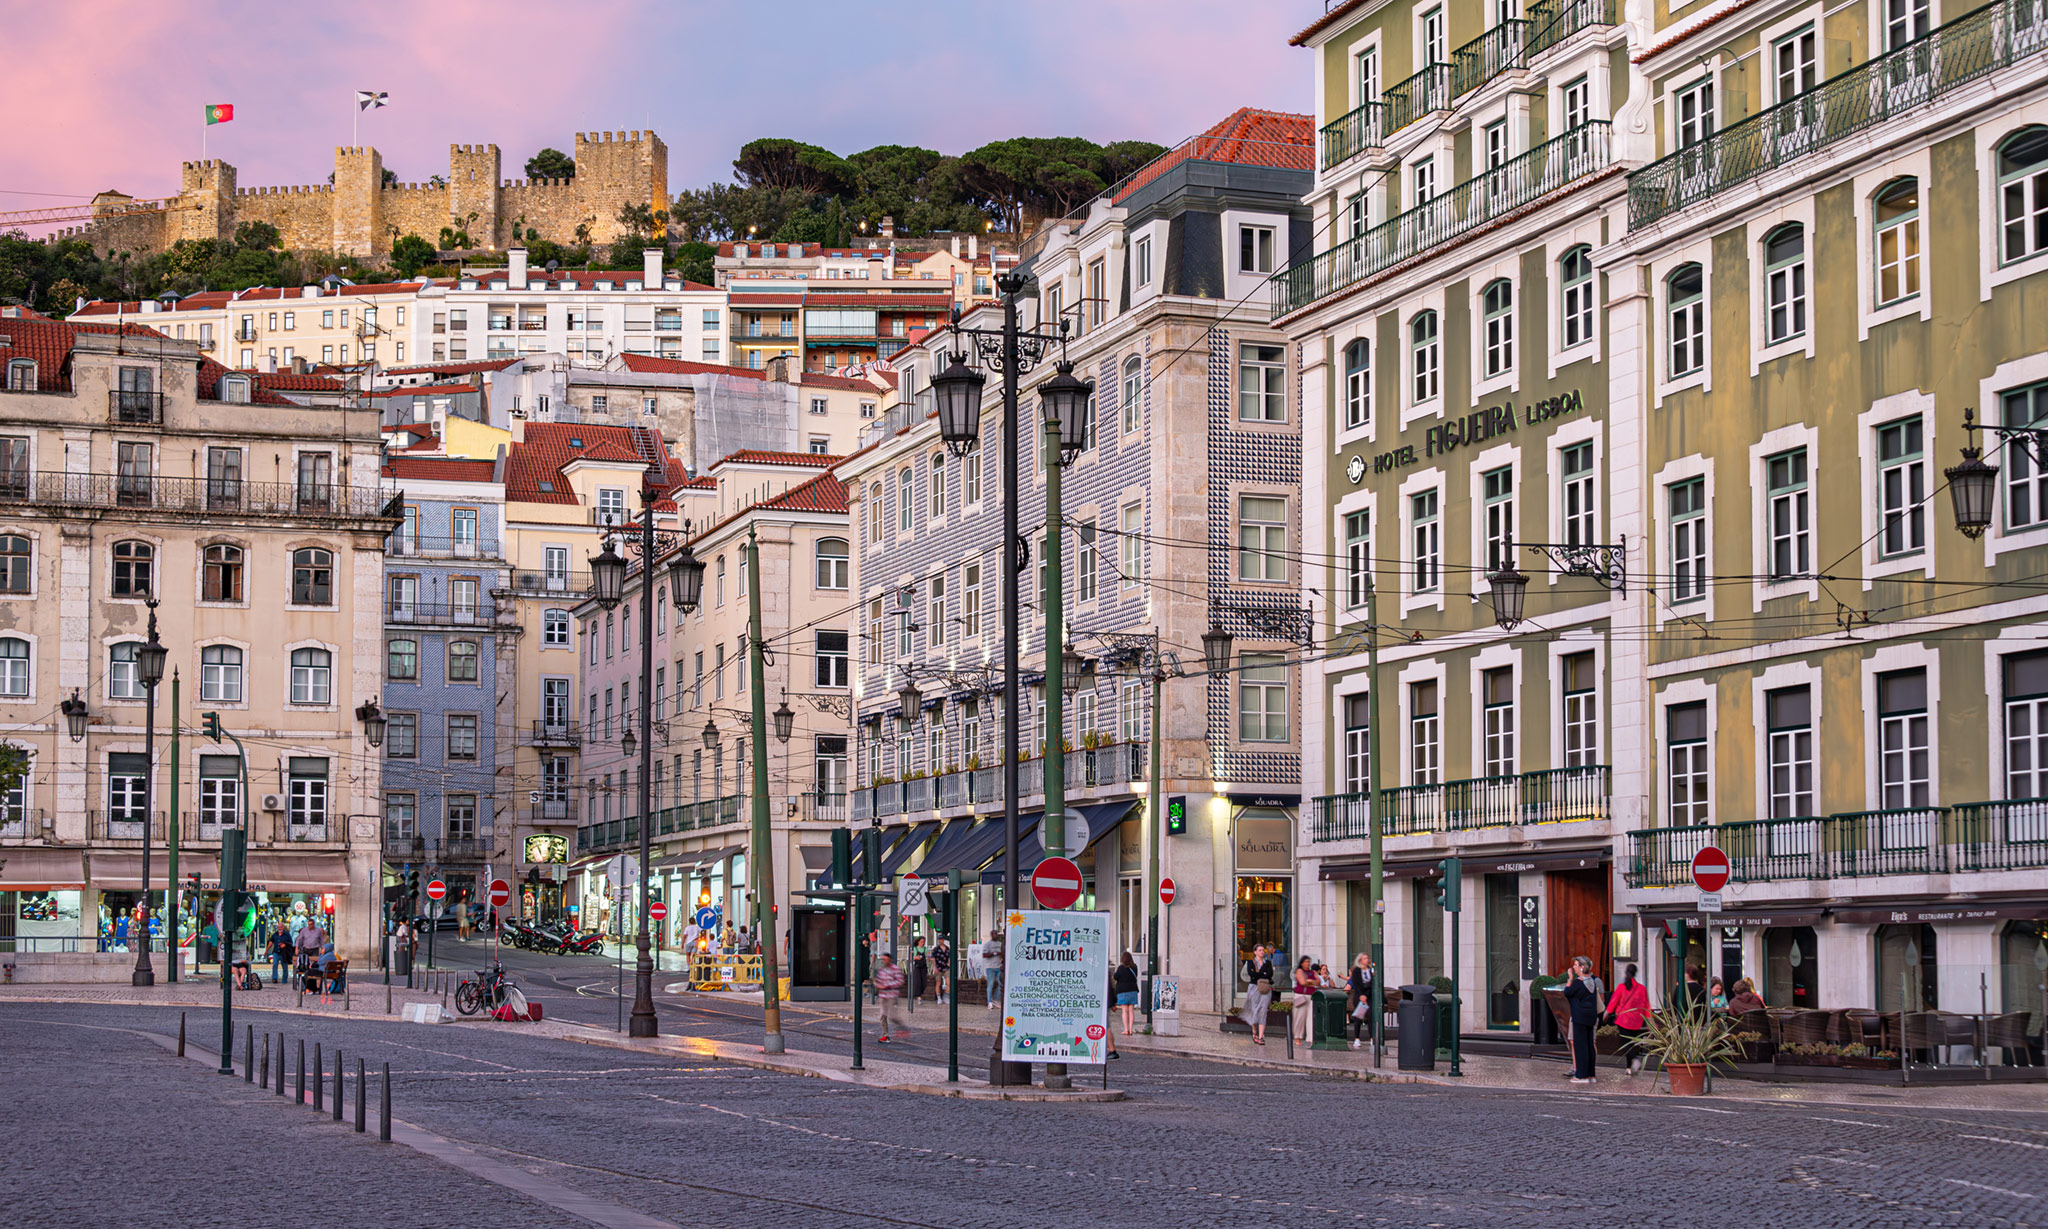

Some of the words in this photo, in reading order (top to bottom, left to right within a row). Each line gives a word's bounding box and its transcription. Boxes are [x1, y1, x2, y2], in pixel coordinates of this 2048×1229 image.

[1374, 445, 1418, 474] HOTEL
[1426, 402, 1518, 458] FIGUEIRA
[1526, 389, 1584, 425] LISBOA
[1026, 928, 1071, 945] FESTA
[1060, 1000, 1100, 1008] DEBATES
